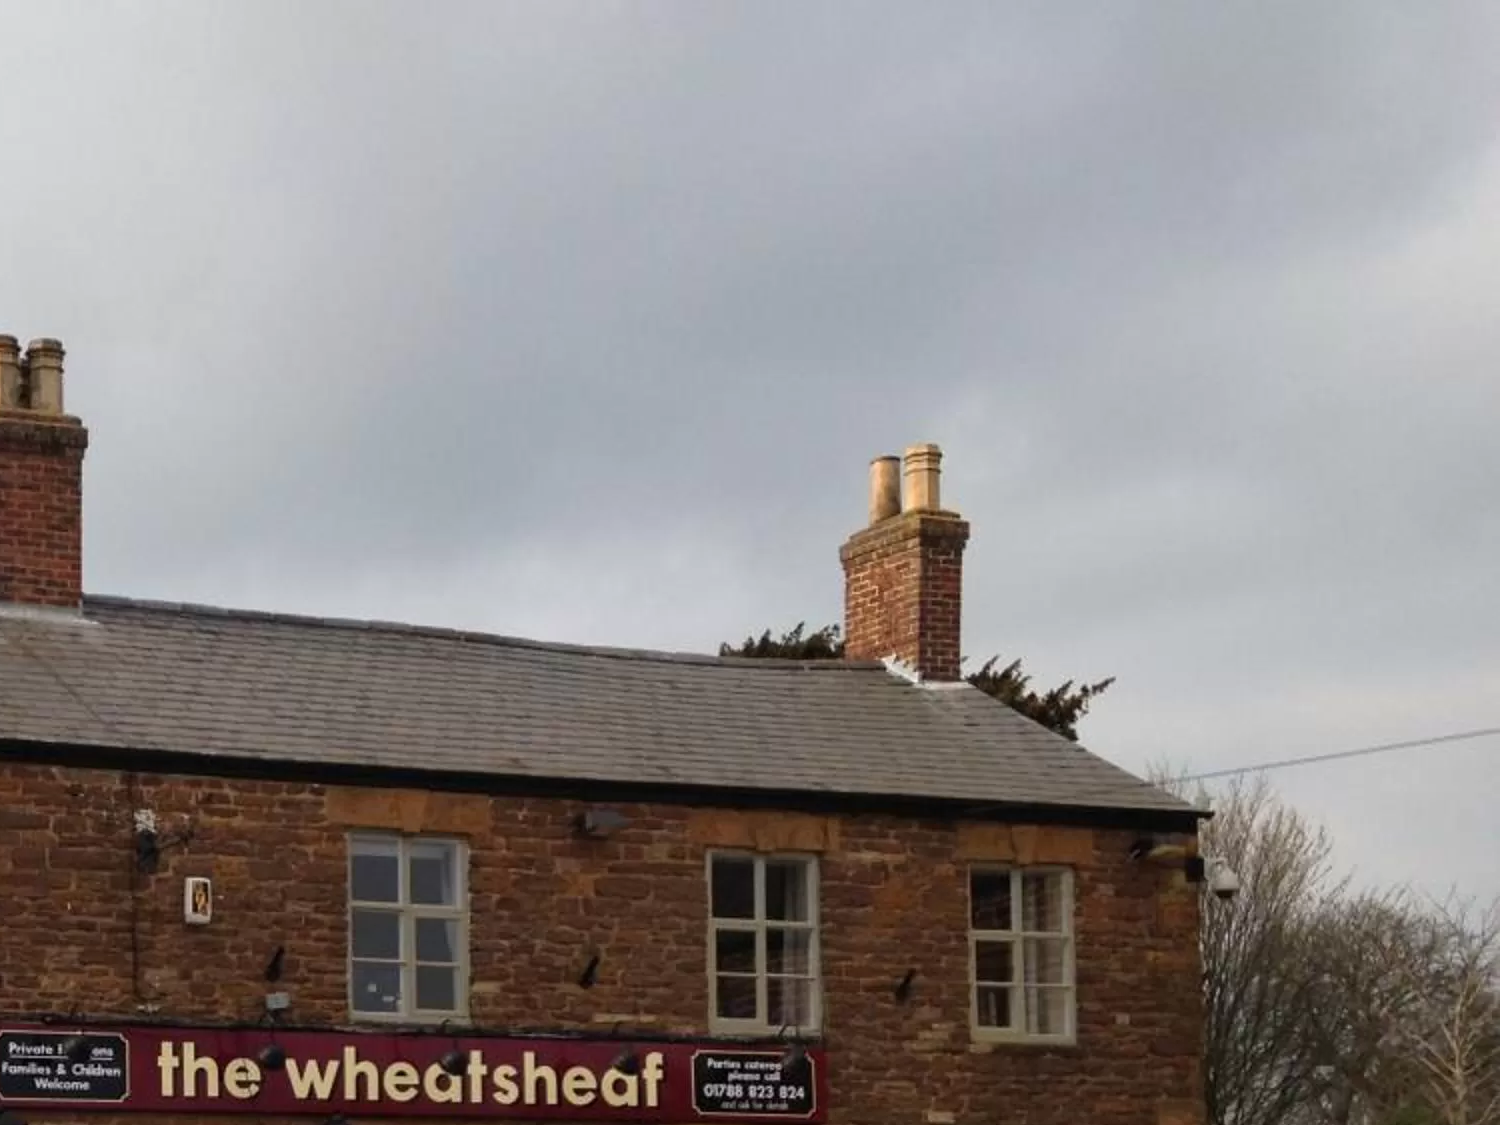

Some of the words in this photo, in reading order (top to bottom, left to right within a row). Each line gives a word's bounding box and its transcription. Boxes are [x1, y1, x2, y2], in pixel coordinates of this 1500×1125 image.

[8, 1041, 53, 1055] Private
[1, 1061, 51, 1075] Families
[56, 1063, 67, 1075] &
[71, 1063, 121, 1077] Children
[157, 1041, 261, 1099] the
[285, 1045, 664, 1108] wheatsheaf
[34, 1078, 90, 1091] Welcome
[703, 1083, 743, 1099] 01788
[748, 1084, 774, 1099] 823
[779, 1085, 805, 1099] 824
